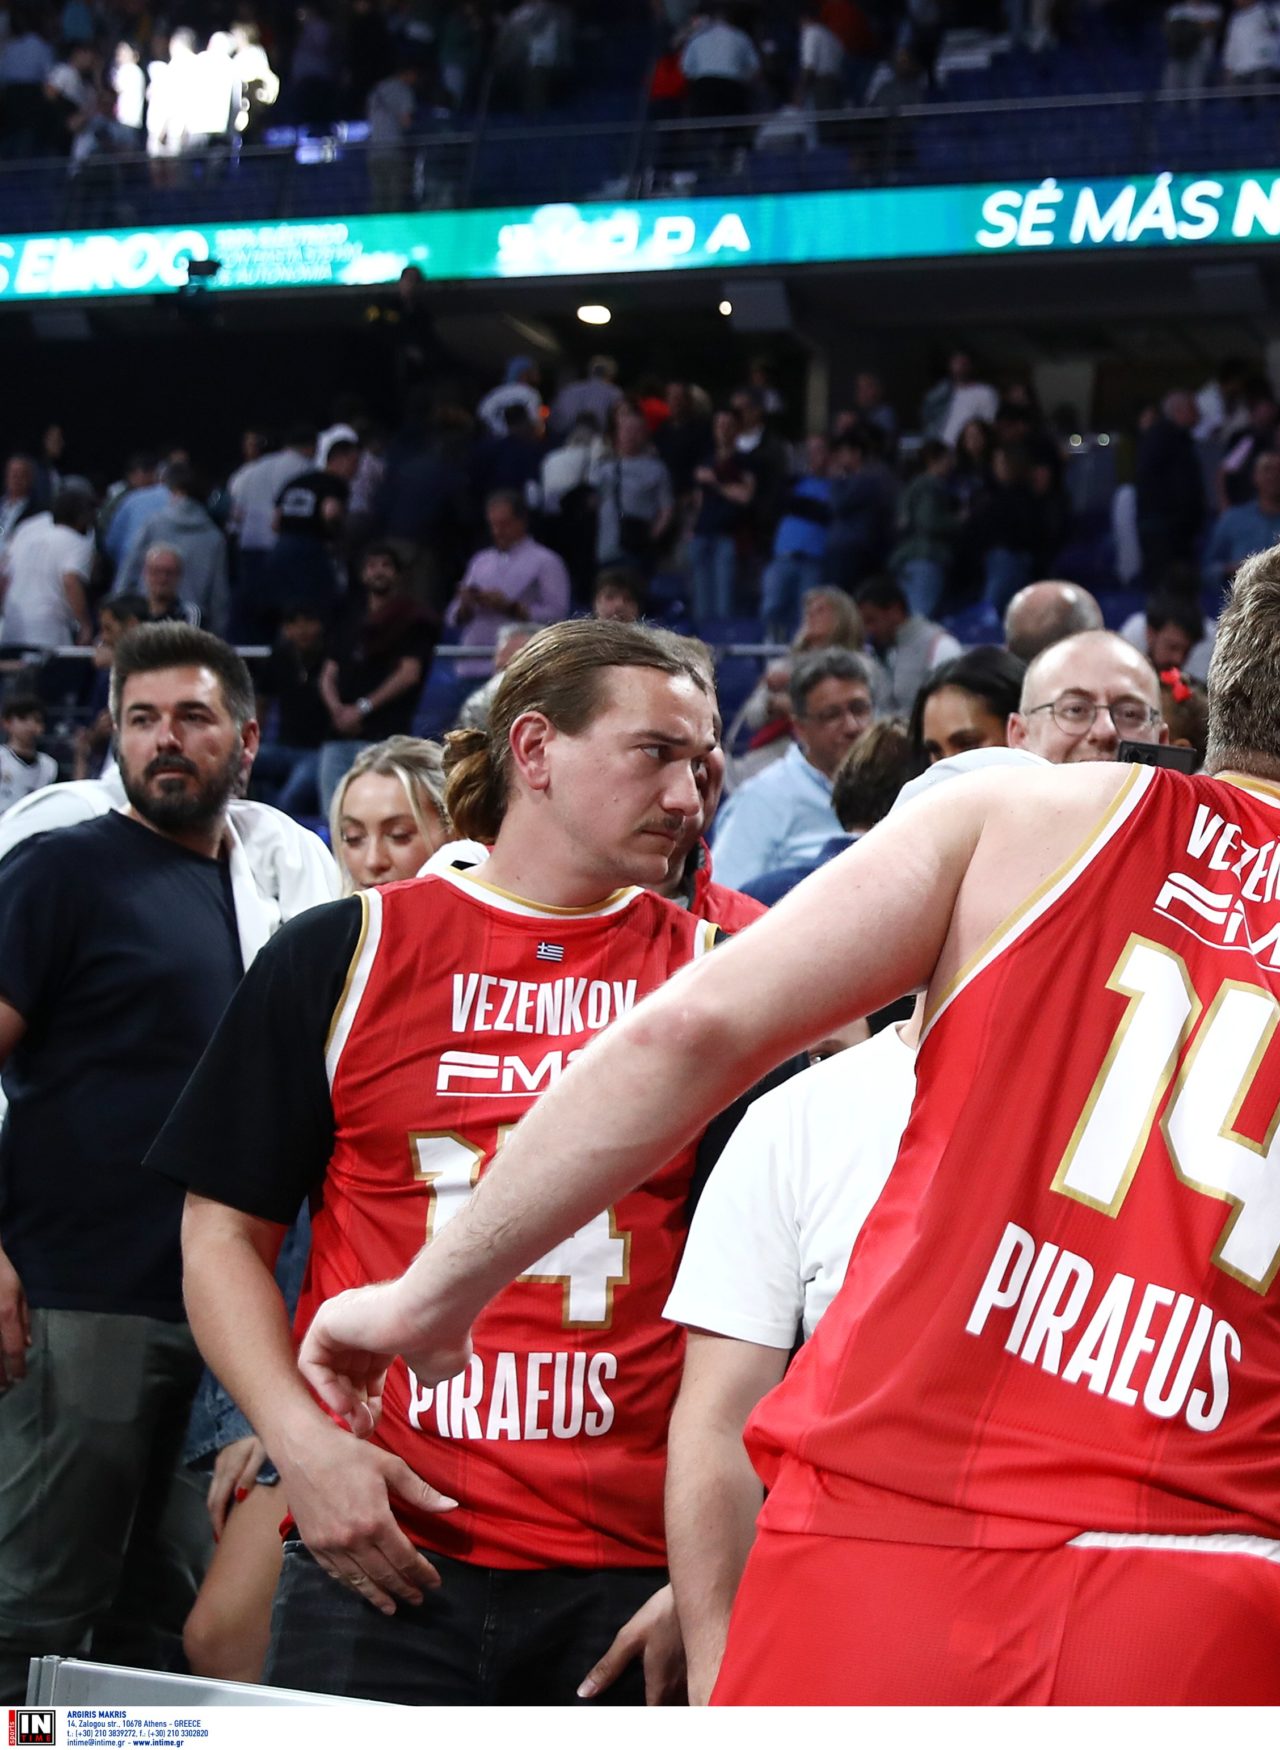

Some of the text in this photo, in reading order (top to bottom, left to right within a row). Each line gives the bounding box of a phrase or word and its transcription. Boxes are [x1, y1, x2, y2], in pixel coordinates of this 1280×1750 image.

[976, 177, 1064, 248] SÉ
[1069, 171, 1224, 243] MÁS
[452, 972, 638, 1036] VEZENKOV
[436, 1050, 584, 1097] FM
[965, 1220, 1243, 1433] PIRAEUS
[408, 1351, 618, 1441] PIRAEUS
